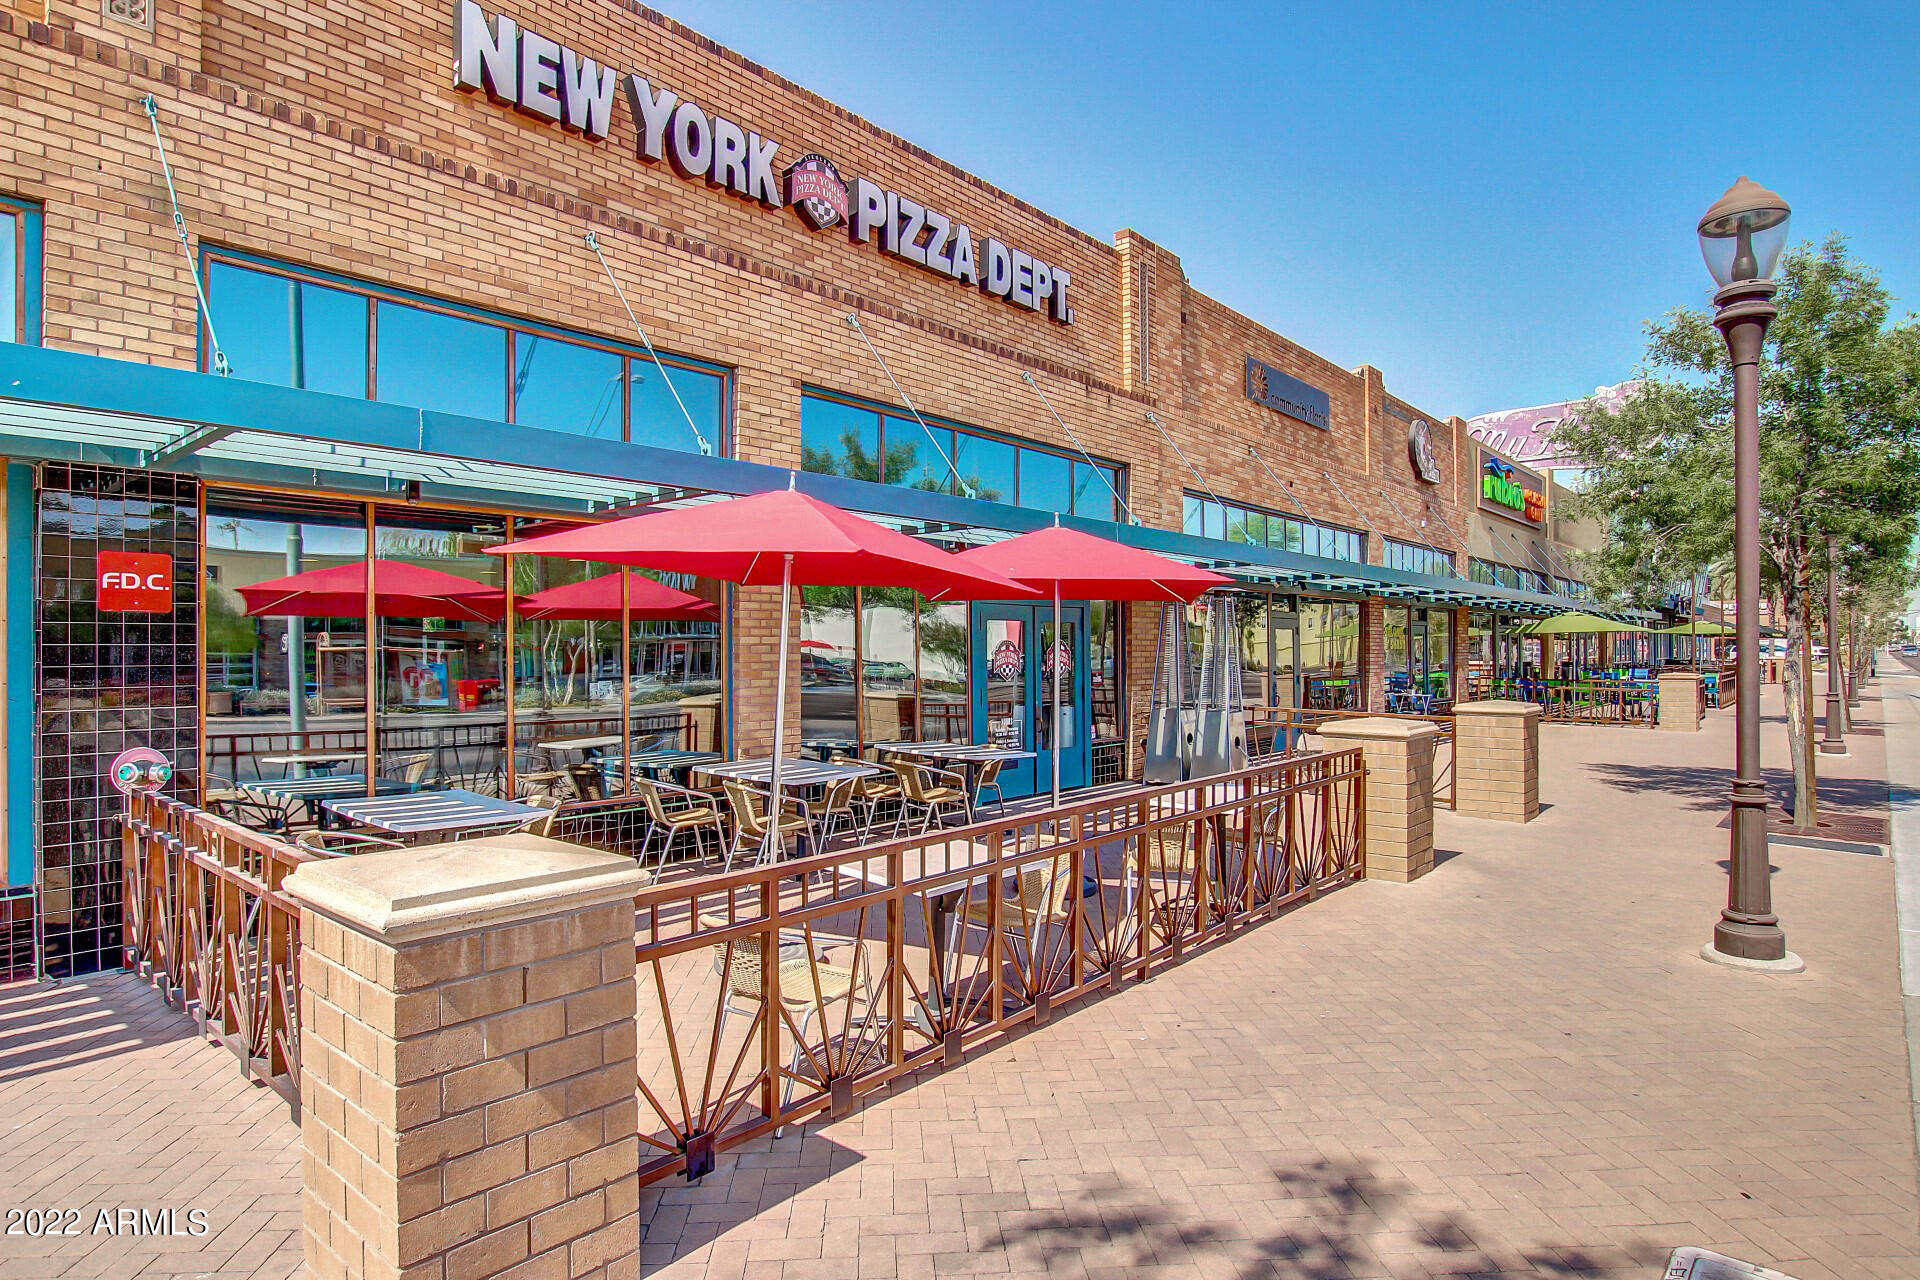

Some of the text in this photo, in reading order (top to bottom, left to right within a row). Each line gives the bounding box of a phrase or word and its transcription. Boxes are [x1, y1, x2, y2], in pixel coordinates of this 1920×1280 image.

[456, 0, 784, 210] NEW YORK
[795, 184, 821, 195] PIZZA
[797, 173, 843, 200] NEW YORK
[854, 177, 1075, 325] PIZZA DEPT.
[1270, 394, 1309, 421] community
[101, 571, 170, 591] F.D.C.
